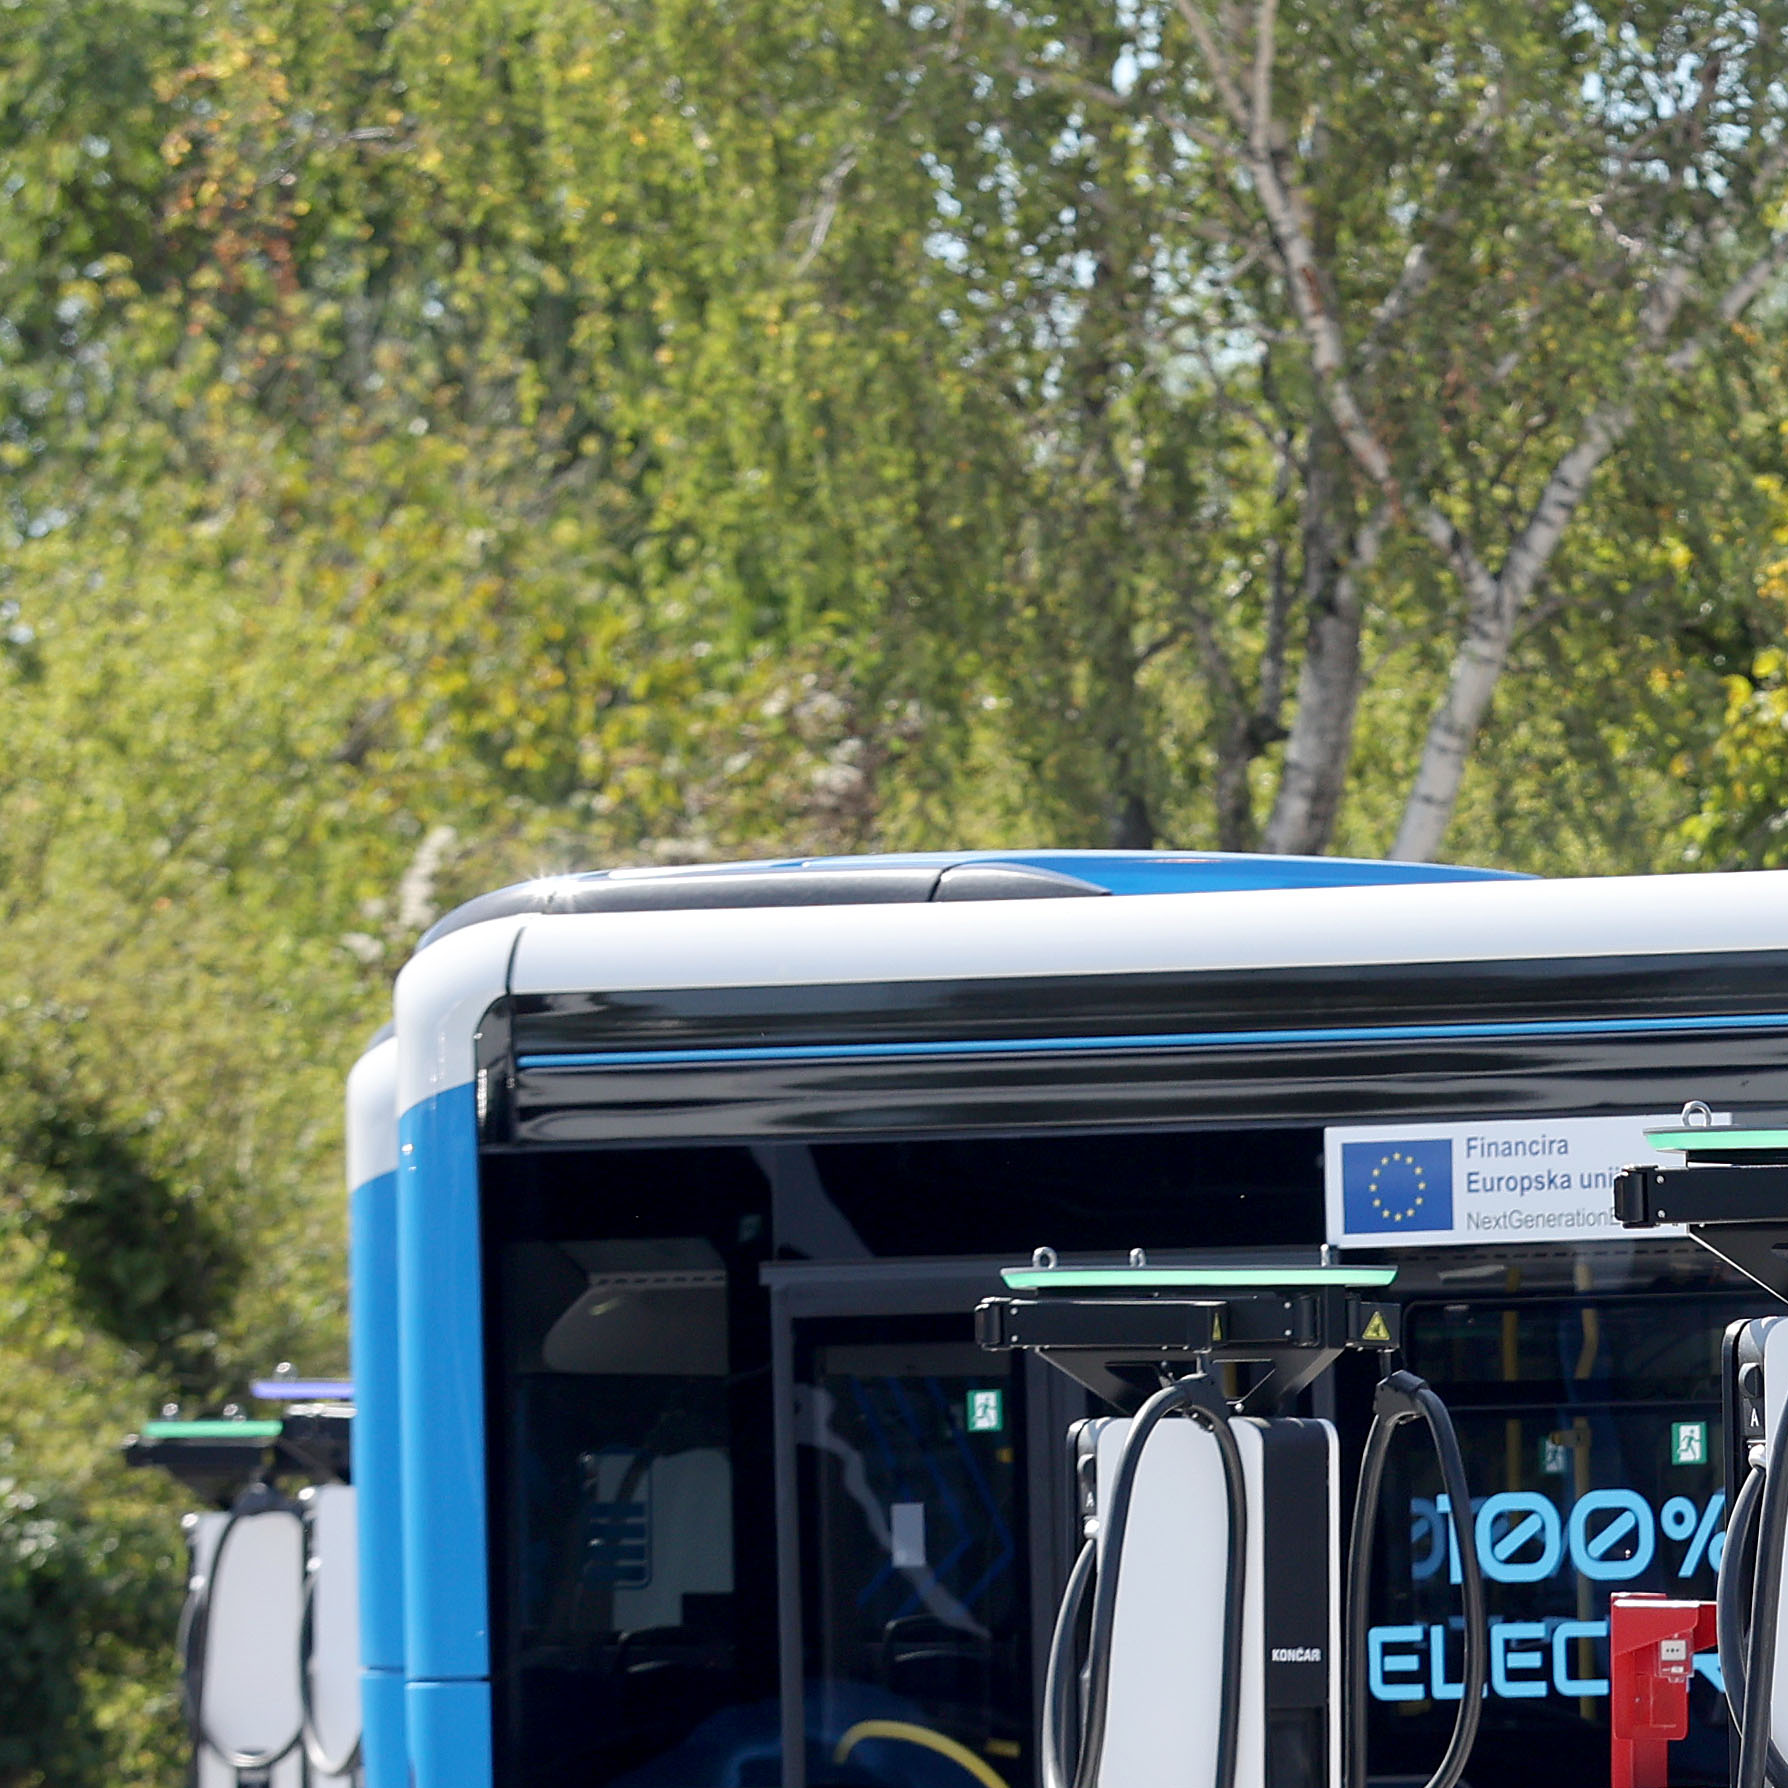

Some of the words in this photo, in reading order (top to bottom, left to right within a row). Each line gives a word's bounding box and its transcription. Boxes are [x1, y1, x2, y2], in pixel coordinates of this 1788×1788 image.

[1466, 1134, 1569, 1158] Financira
[1466, 1169, 1572, 1196] Europska
[1580, 1166, 1618, 1189] uni
[1466, 1207, 1620, 1231] NextGenerationE
[1751, 1408, 1760, 1427] A
[1436, 1489, 1725, 1585] 100%
[1271, 1646, 1322, 1663] KONČAR
